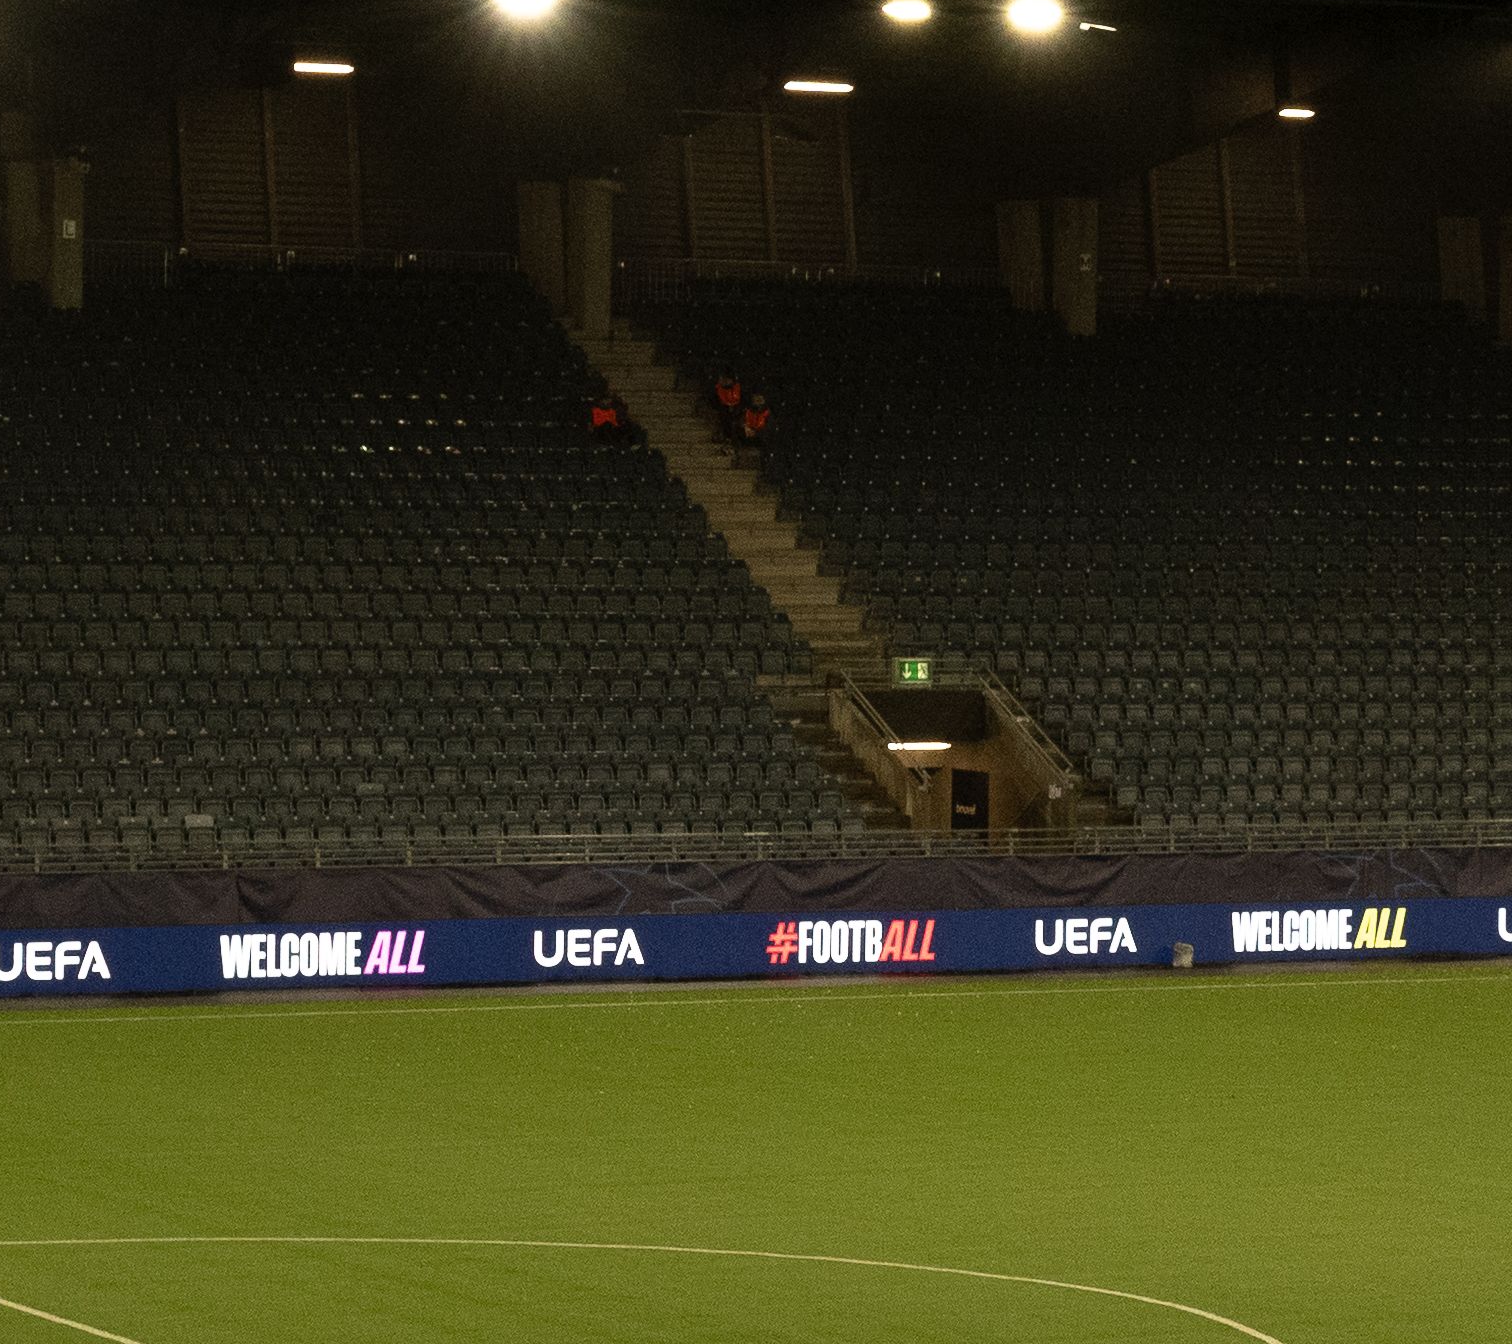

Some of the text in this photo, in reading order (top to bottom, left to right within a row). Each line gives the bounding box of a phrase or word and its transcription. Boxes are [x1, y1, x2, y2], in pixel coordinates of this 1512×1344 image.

[534, 929, 646, 969] UEFA
[767, 920, 936, 965] #FOOTBALL
[1034, 917, 1138, 956] UEFA
[1233, 908, 1408, 953] WELCOME ALL
[221, 931, 427, 979] WELCOME ALL
